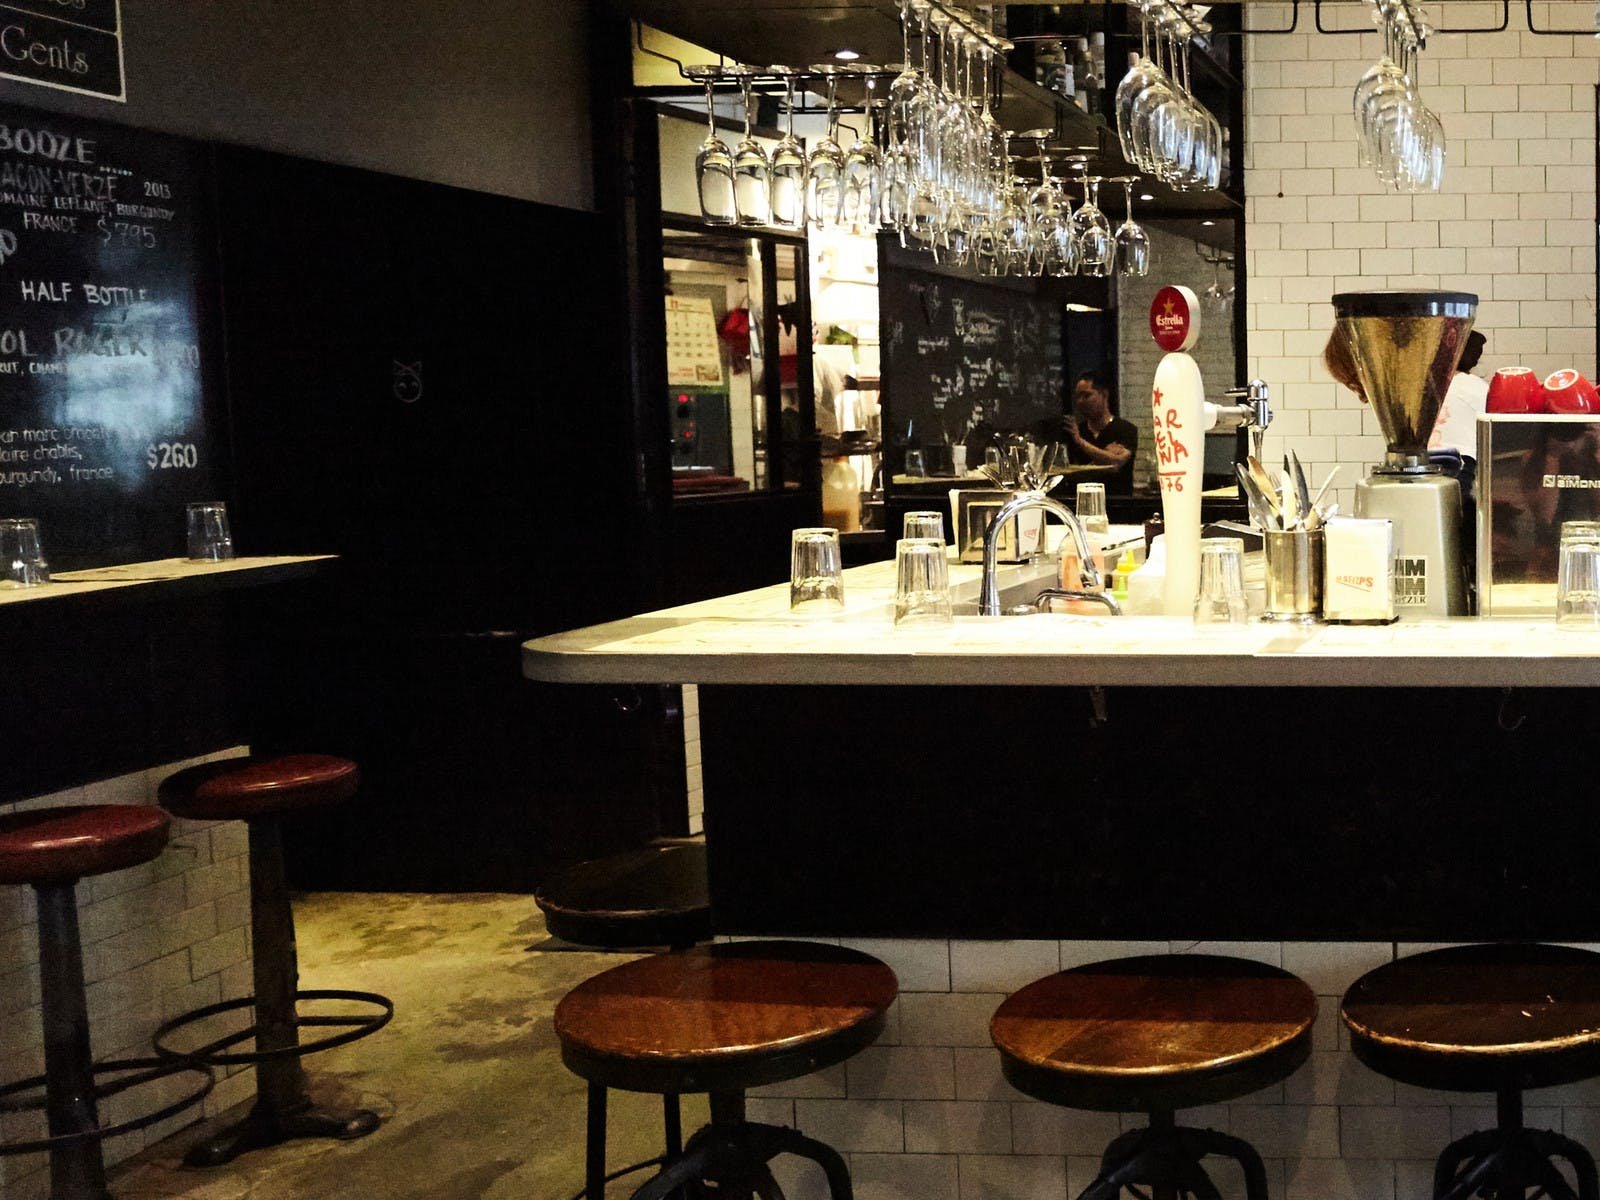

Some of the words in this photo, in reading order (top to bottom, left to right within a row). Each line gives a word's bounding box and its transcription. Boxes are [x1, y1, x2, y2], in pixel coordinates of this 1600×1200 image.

[143, 181, 172, 199] 2013
[23, 211, 78, 233] FRANCE
[21, 279, 73, 303] HALF
[147, 442, 198, 470] $260
